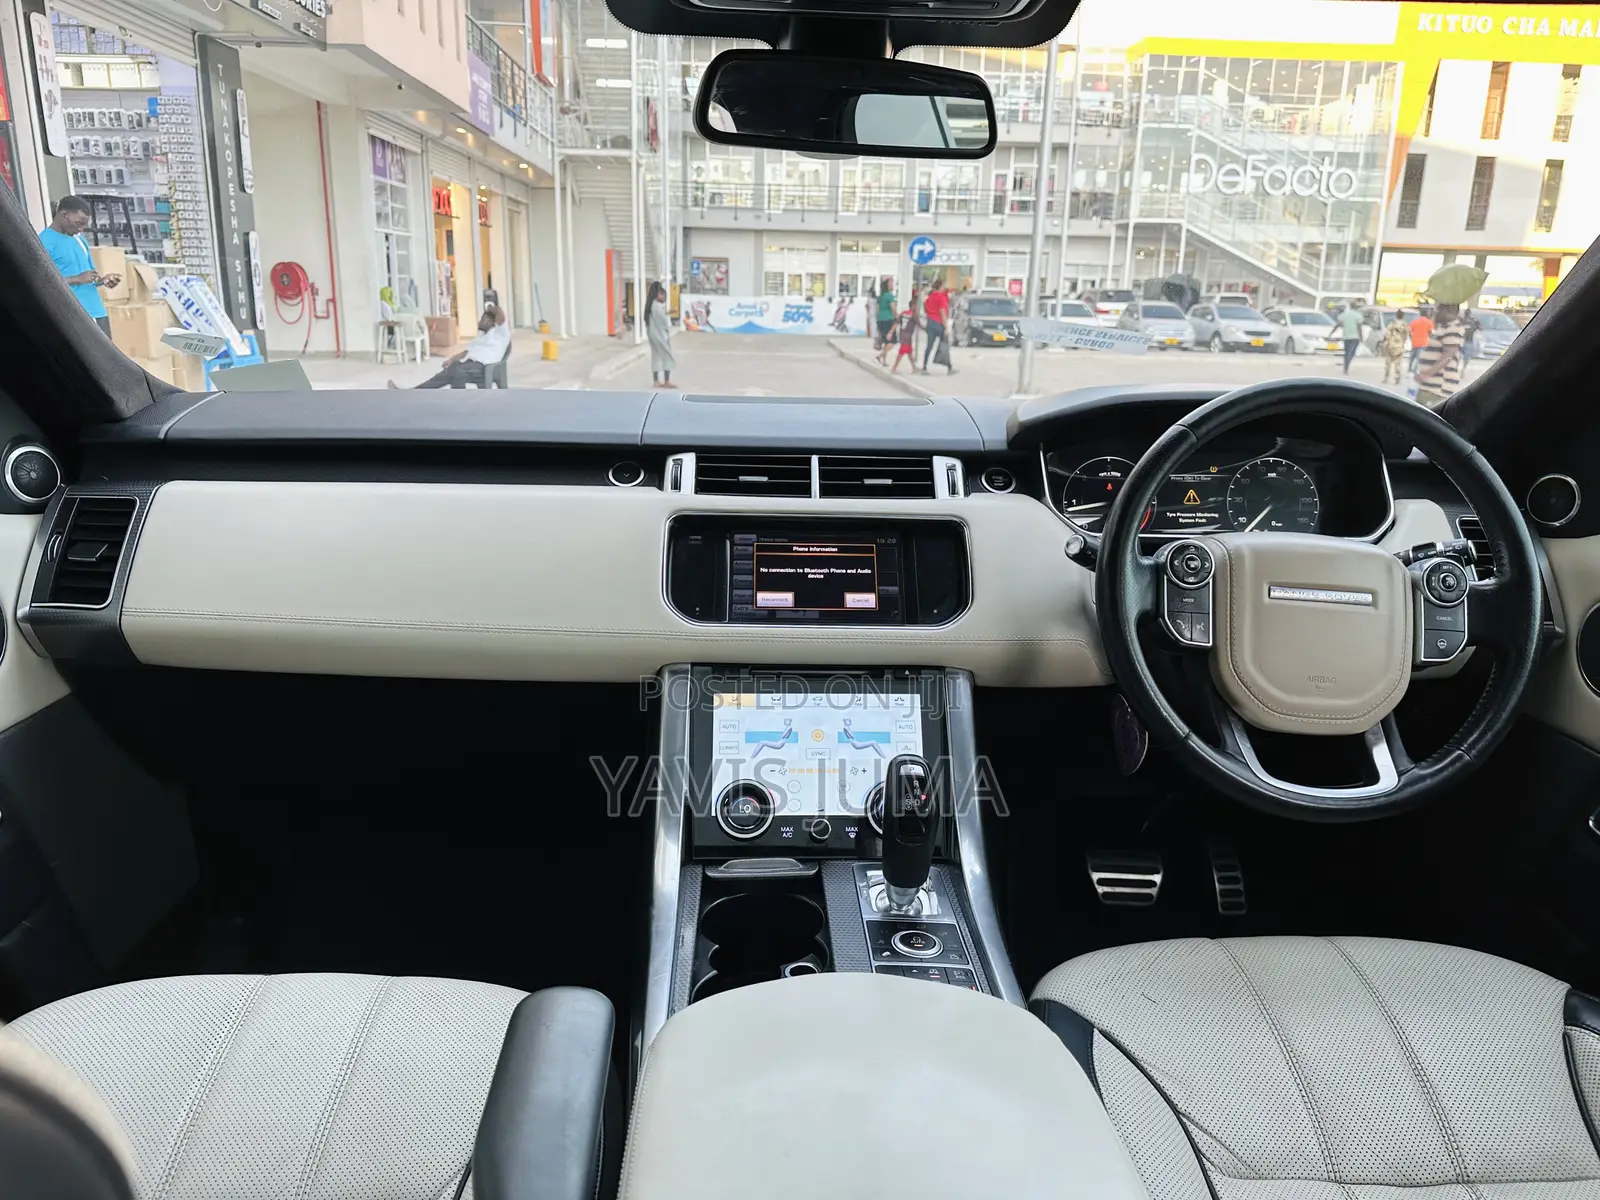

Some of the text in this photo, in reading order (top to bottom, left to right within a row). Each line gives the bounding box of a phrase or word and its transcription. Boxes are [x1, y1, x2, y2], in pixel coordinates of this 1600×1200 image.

[1417, 13, 1600, 38] KITUO CHA MA
[1188, 153, 1357, 199] DeFacto
[217, 64, 248, 320] TUNAKOPESHA SIMU
[1071, 498, 1077, 506] 1
[1305, 675, 1338, 685] AIRBAG
[739, 804, 751, 814] LO
